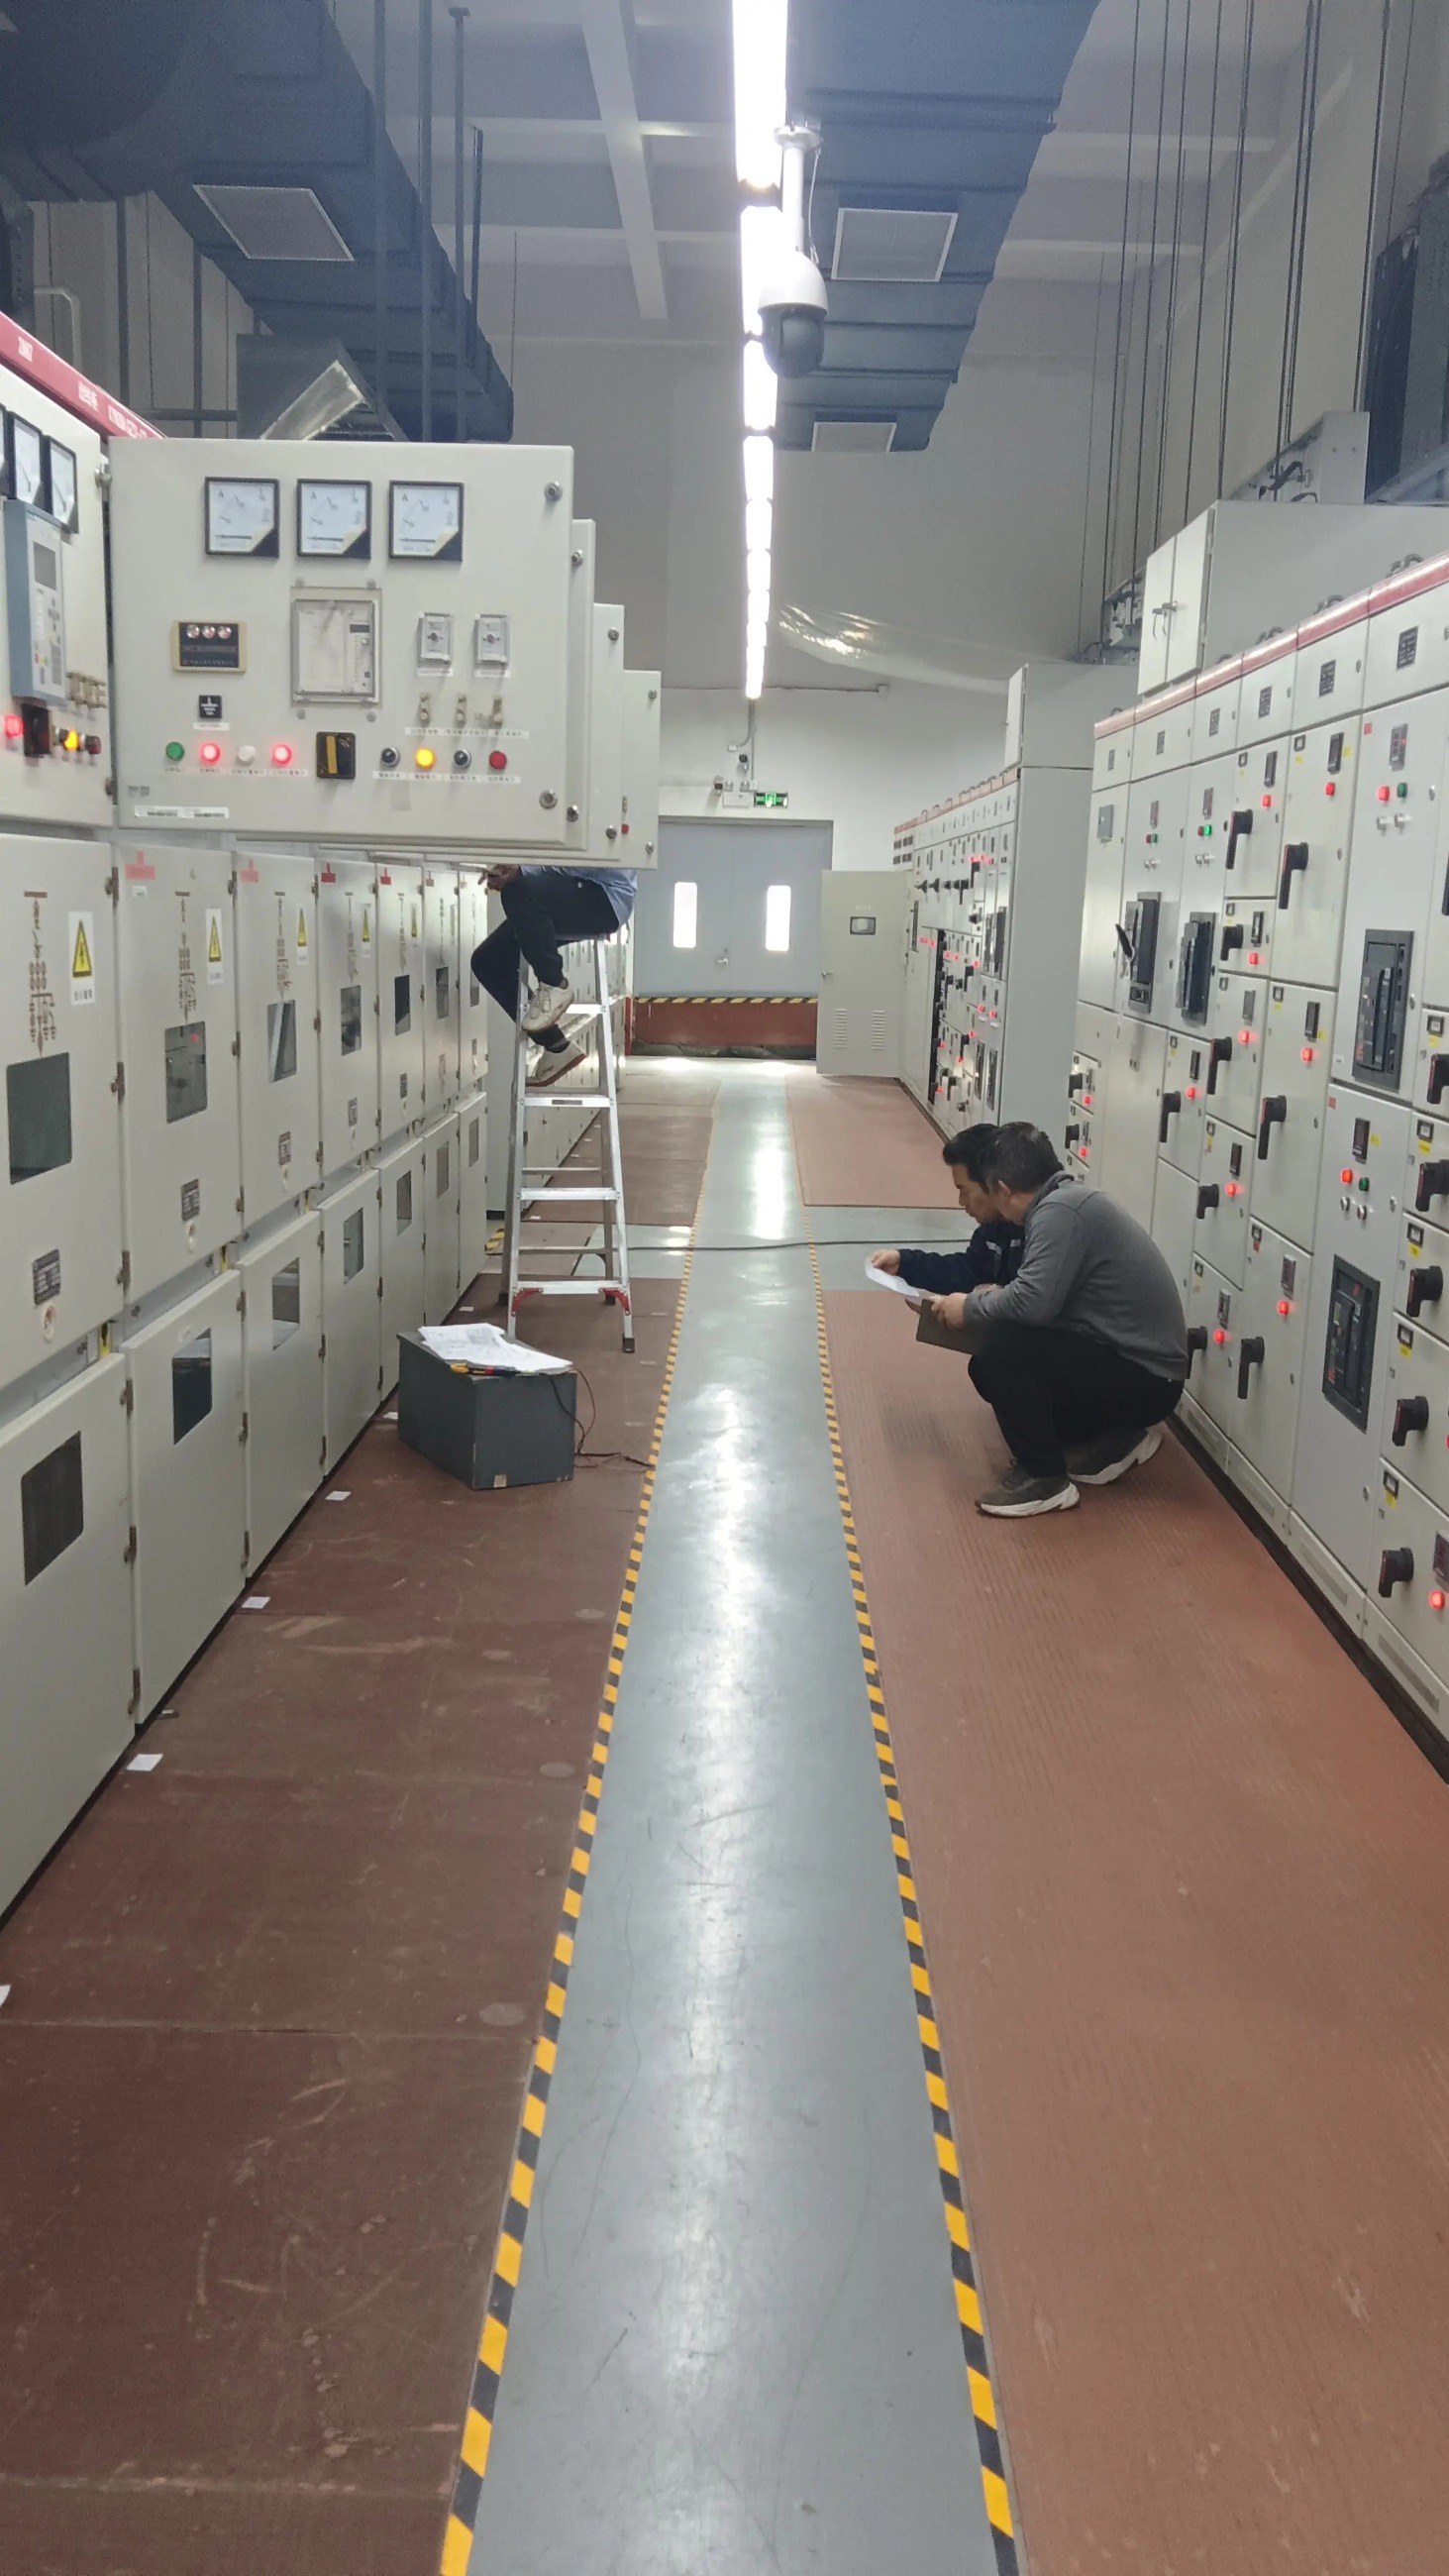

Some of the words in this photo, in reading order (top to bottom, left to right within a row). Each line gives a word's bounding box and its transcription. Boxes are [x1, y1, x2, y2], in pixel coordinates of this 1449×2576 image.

[218, 489, 225, 498] A
[311, 491, 317, 500] A
[402, 492, 408, 501] A
